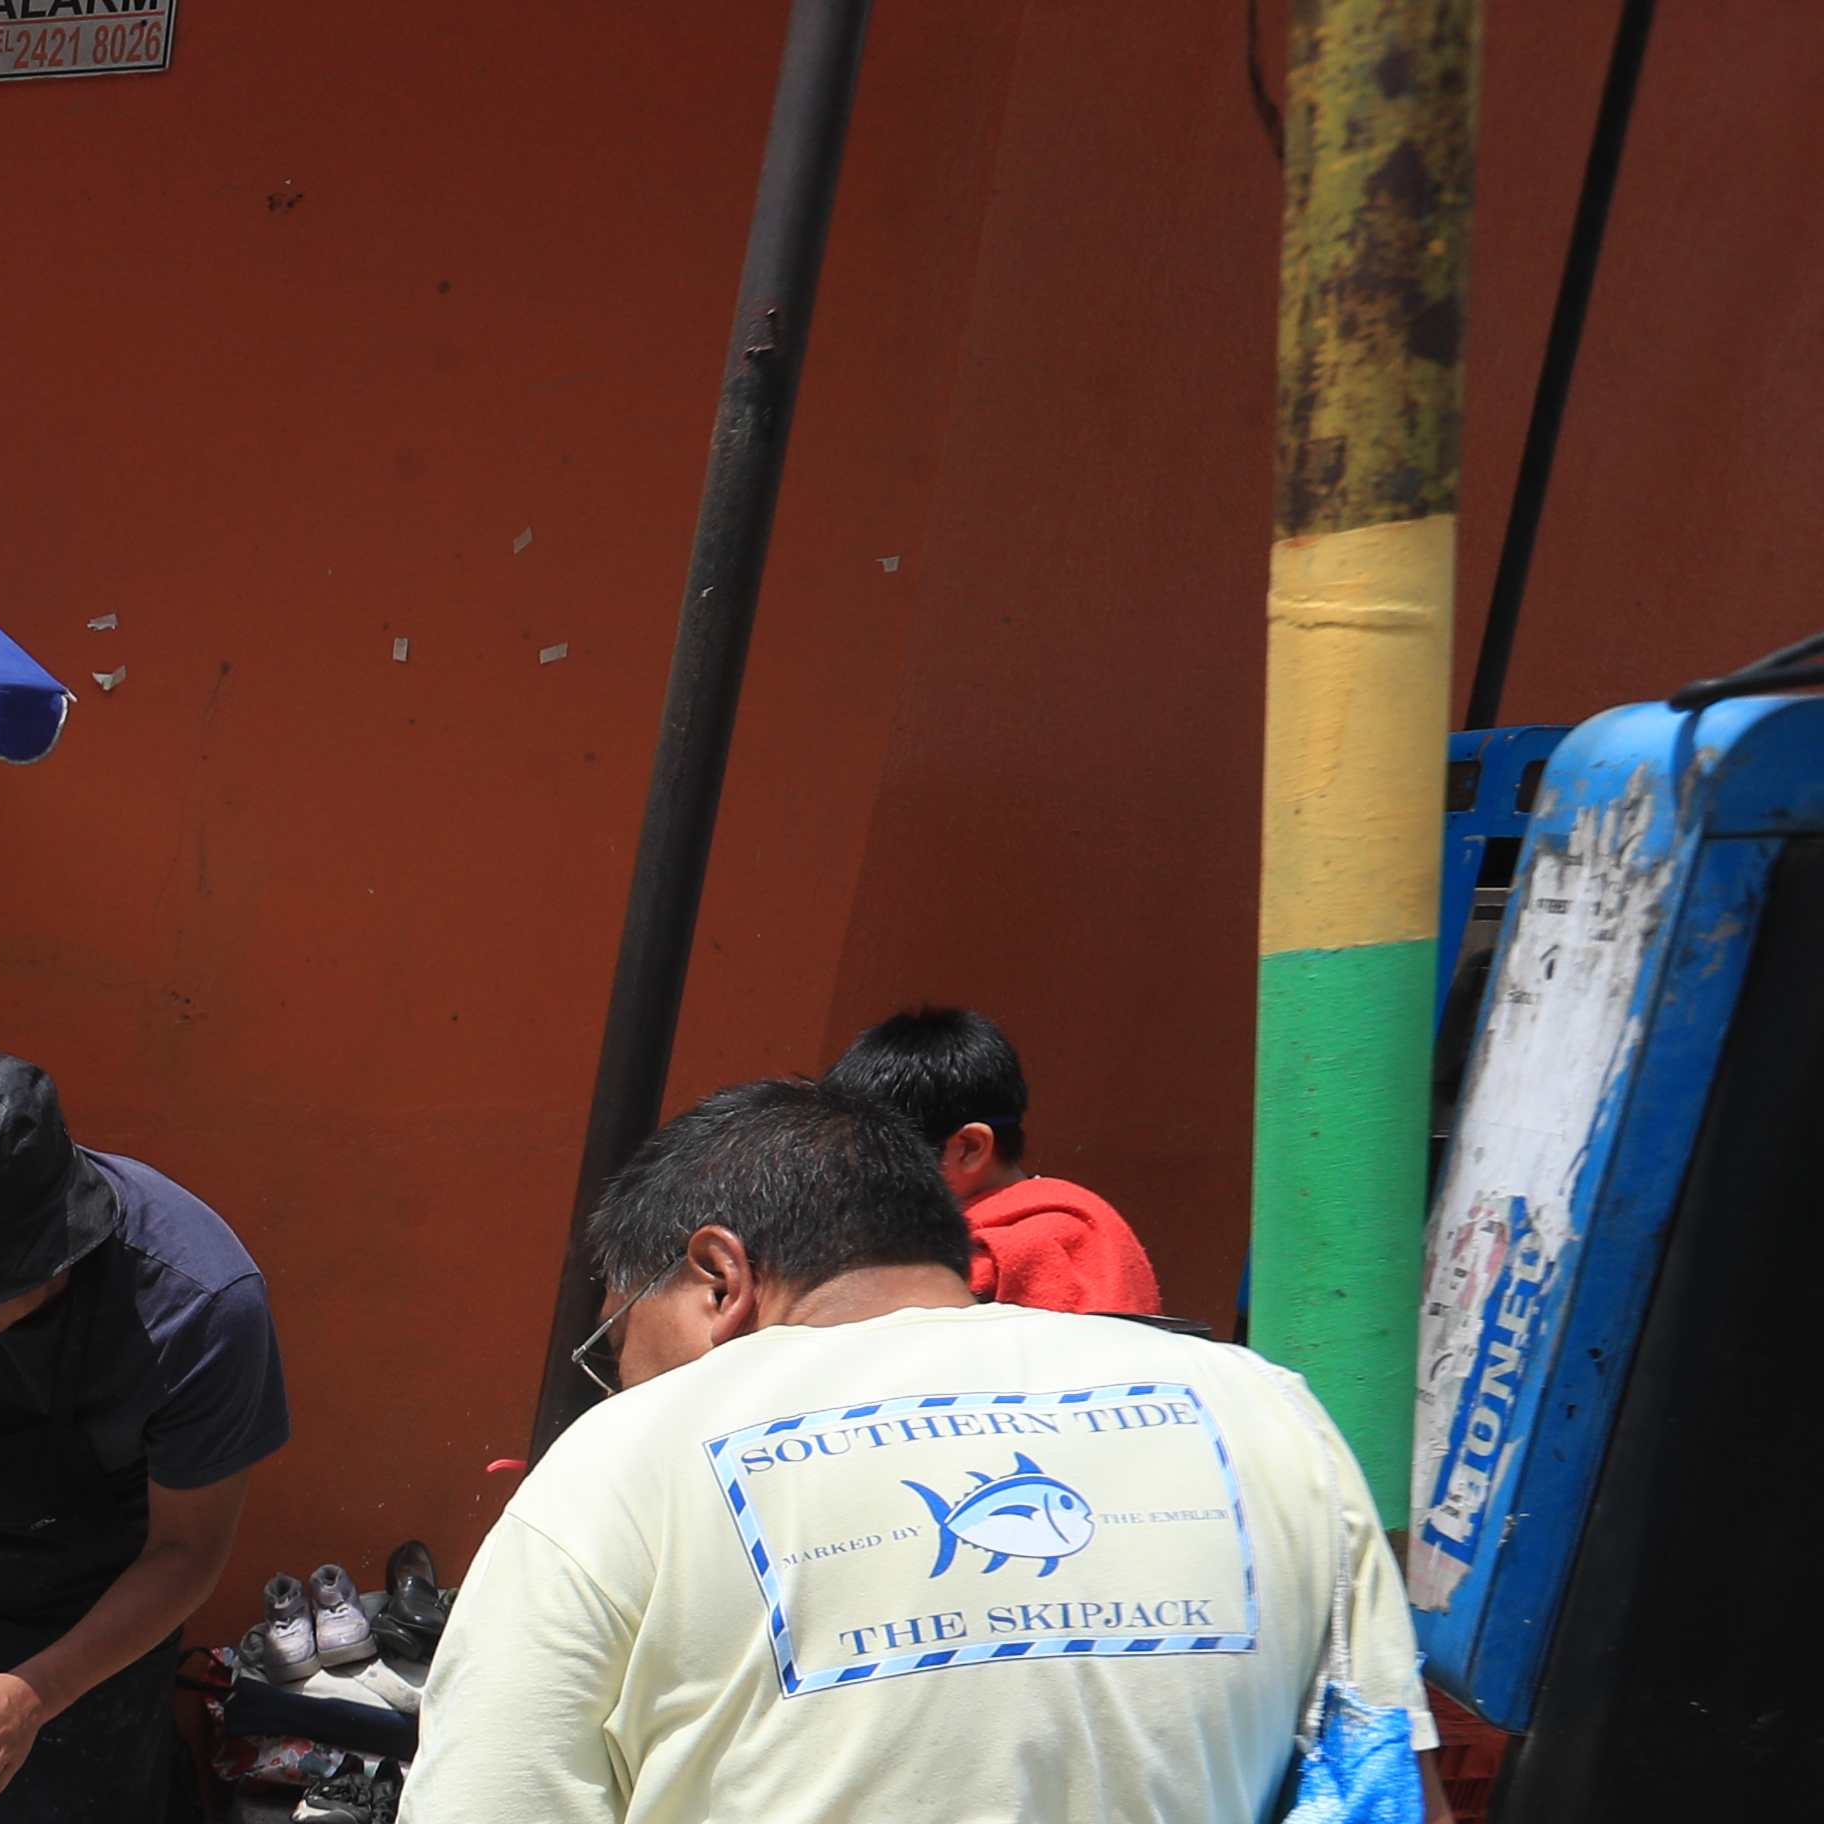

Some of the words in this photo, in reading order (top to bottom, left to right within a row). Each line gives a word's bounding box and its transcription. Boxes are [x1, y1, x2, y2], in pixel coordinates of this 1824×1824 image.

[14, 26, 82, 70] 2421
[92, 20, 162, 65] 8026
[739, 1411, 1061, 1475] SOUTHERN
[1073, 1402, 1199, 1433] TIDE
[1099, 1511, 1145, 1525] THE
[1150, 1508, 1231, 1523] EMBLEM
[782, 1534, 883, 1570] MARKED
[892, 1525, 923, 1543] BY
[839, 1610, 969, 1658] THE
[986, 1599, 1214, 1634] SKIPJACK
